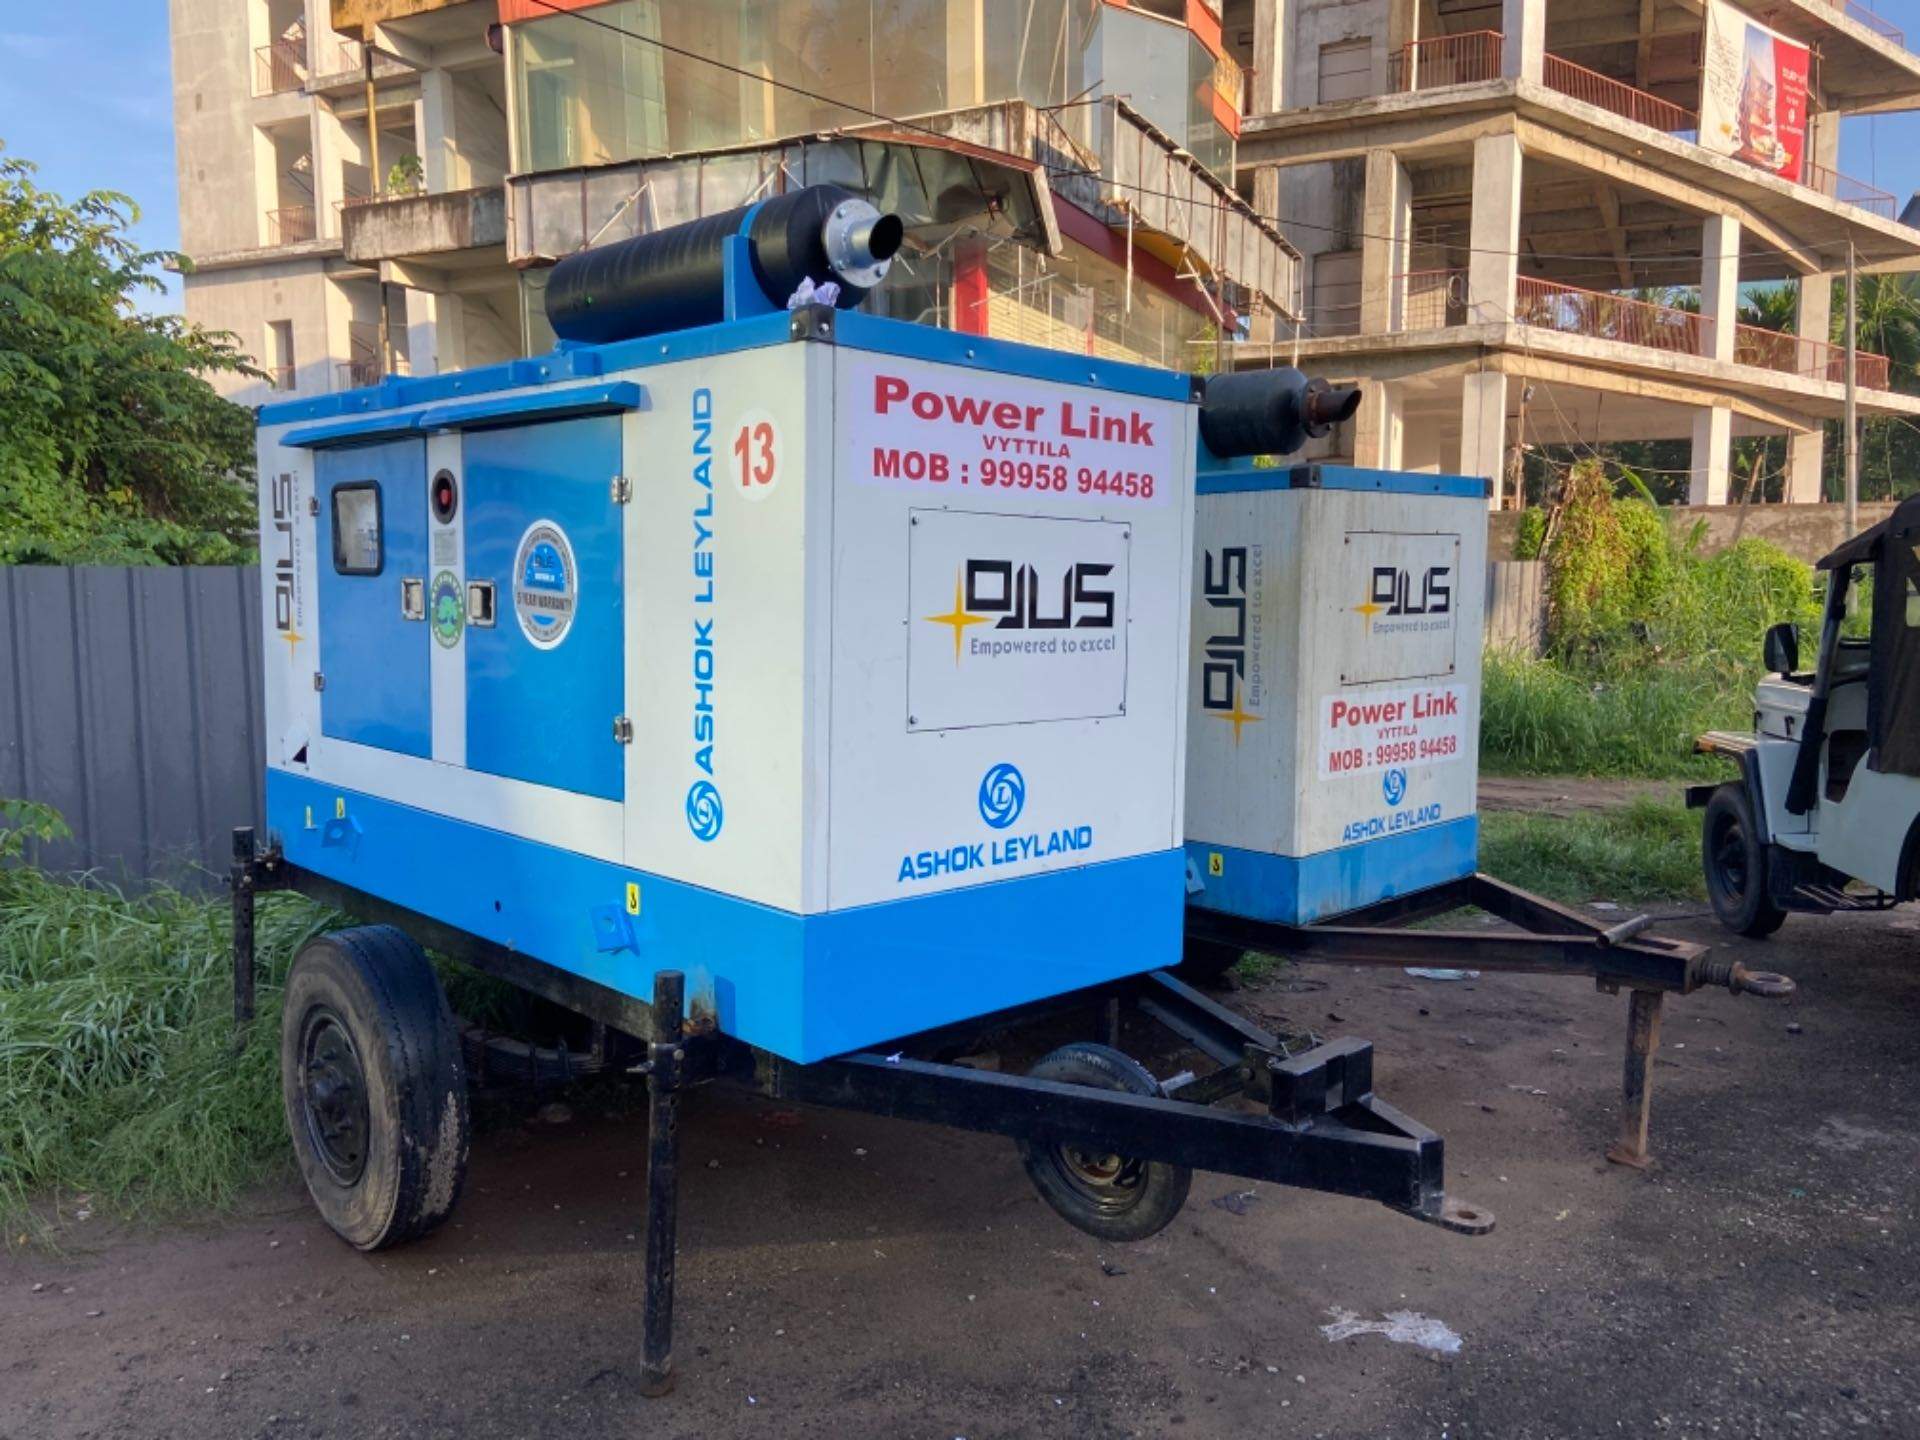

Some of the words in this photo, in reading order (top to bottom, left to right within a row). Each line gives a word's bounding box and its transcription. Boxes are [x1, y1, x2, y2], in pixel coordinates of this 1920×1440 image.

[873, 375, 1044, 433] Power
[1060, 402, 1154, 447] Link
[734, 421, 775, 487] 13
[983, 434, 1071, 459] VYTTILA
[692, 387, 713, 603] LEYLAND
[873, 447, 949, 482] MOB
[980, 458, 1068, 492] 99958
[1077, 468, 1154, 499] 94458
[971, 636, 1057, 658] Empowered
[1062, 639, 1077, 654] to
[1080, 634, 1116, 653] excel
[694, 618, 714, 776] ASHOK
[1330, 700, 1406, 729] Power
[1412, 690, 1458, 719] Link
[1328, 748, 1363, 773] MOB
[1376, 740, 1416, 765] 99958
[1420, 735, 1457, 758] 94458
[1376, 724, 1418, 740] VYTTILA
[1342, 815, 1386, 843] ASHOK
[1388, 802, 1441, 831] LEYLAND
[897, 843, 985, 883] ASHOK
[991, 825, 1092, 865] LEYLAND
